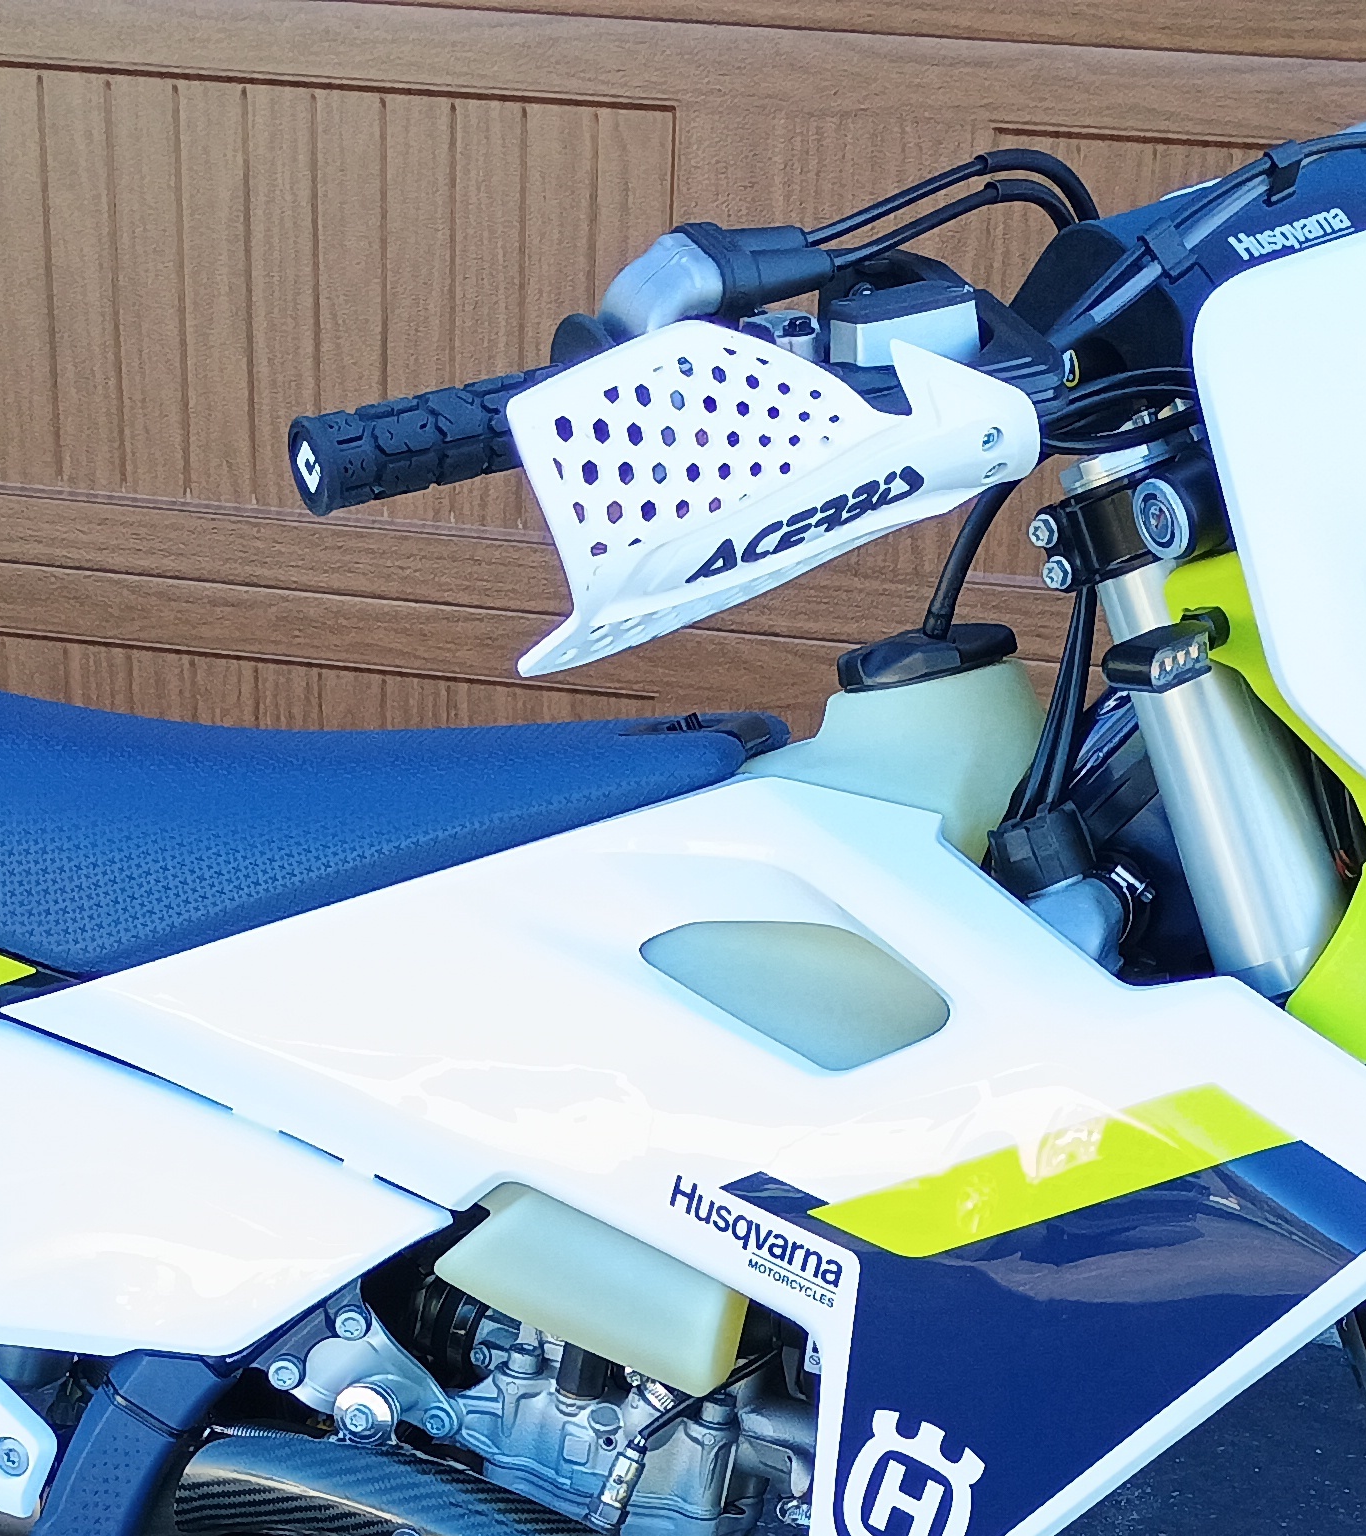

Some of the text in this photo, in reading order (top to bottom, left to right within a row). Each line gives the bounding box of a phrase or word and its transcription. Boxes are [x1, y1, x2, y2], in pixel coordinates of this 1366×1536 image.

[1227, 208, 1352, 261] Husqvarna
[685, 465, 924, 584] ACERBIS
[669, 1174, 843, 1288] Husqvarna
[747, 1258, 835, 1308] MOTORCYCLES
